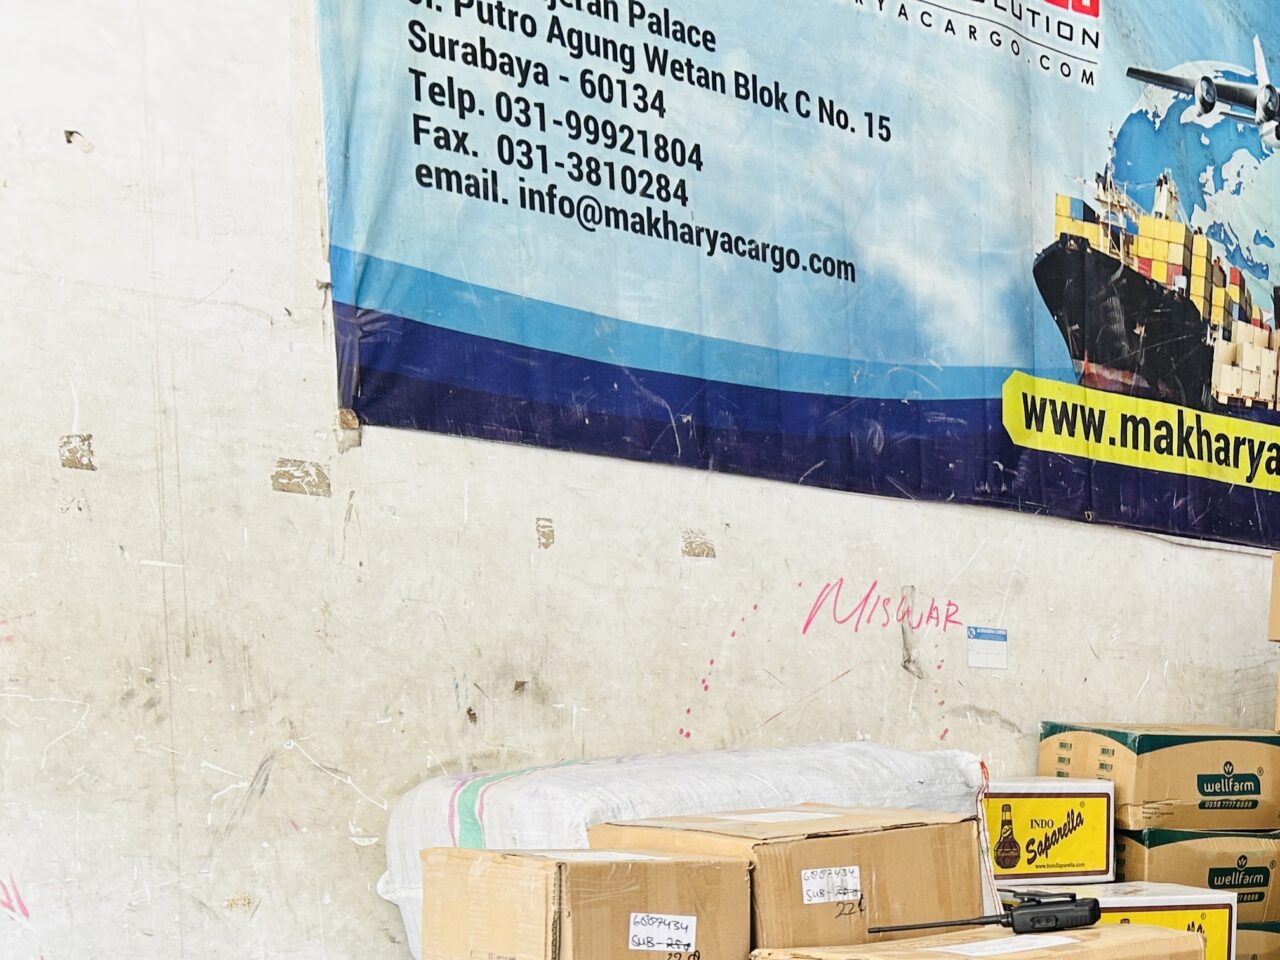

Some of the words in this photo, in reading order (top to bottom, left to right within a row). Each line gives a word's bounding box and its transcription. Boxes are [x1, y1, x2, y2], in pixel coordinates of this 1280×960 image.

[628, 0, 717, 53] Palace
[407, 19, 550, 88] Surabaya
[579, 68, 666, 119] 60134
[546, 14, 636, 75] Agung
[643, 42, 726, 96] Wetan
[734, 73, 789, 114] Blok
[794, 90, 811, 119] C
[818, 96, 856, 134] No.
[864, 111, 892, 143] 15
[407, 66, 485, 120] Telp.
[494, 90, 705, 172] 031-99921804
[412, 112, 479, 158] Fax.
[496, 132, 689, 207] 031-3810284
[414, 160, 510, 206] email.
[518, 182, 857, 284] info@makharyacargo.com
[1203, 777, 1255, 793] wellfarm
[1025, 808, 1085, 866] Saparella
[1030, 818, 1055, 829] INDO
[1213, 871, 1264, 886] wellfarm
